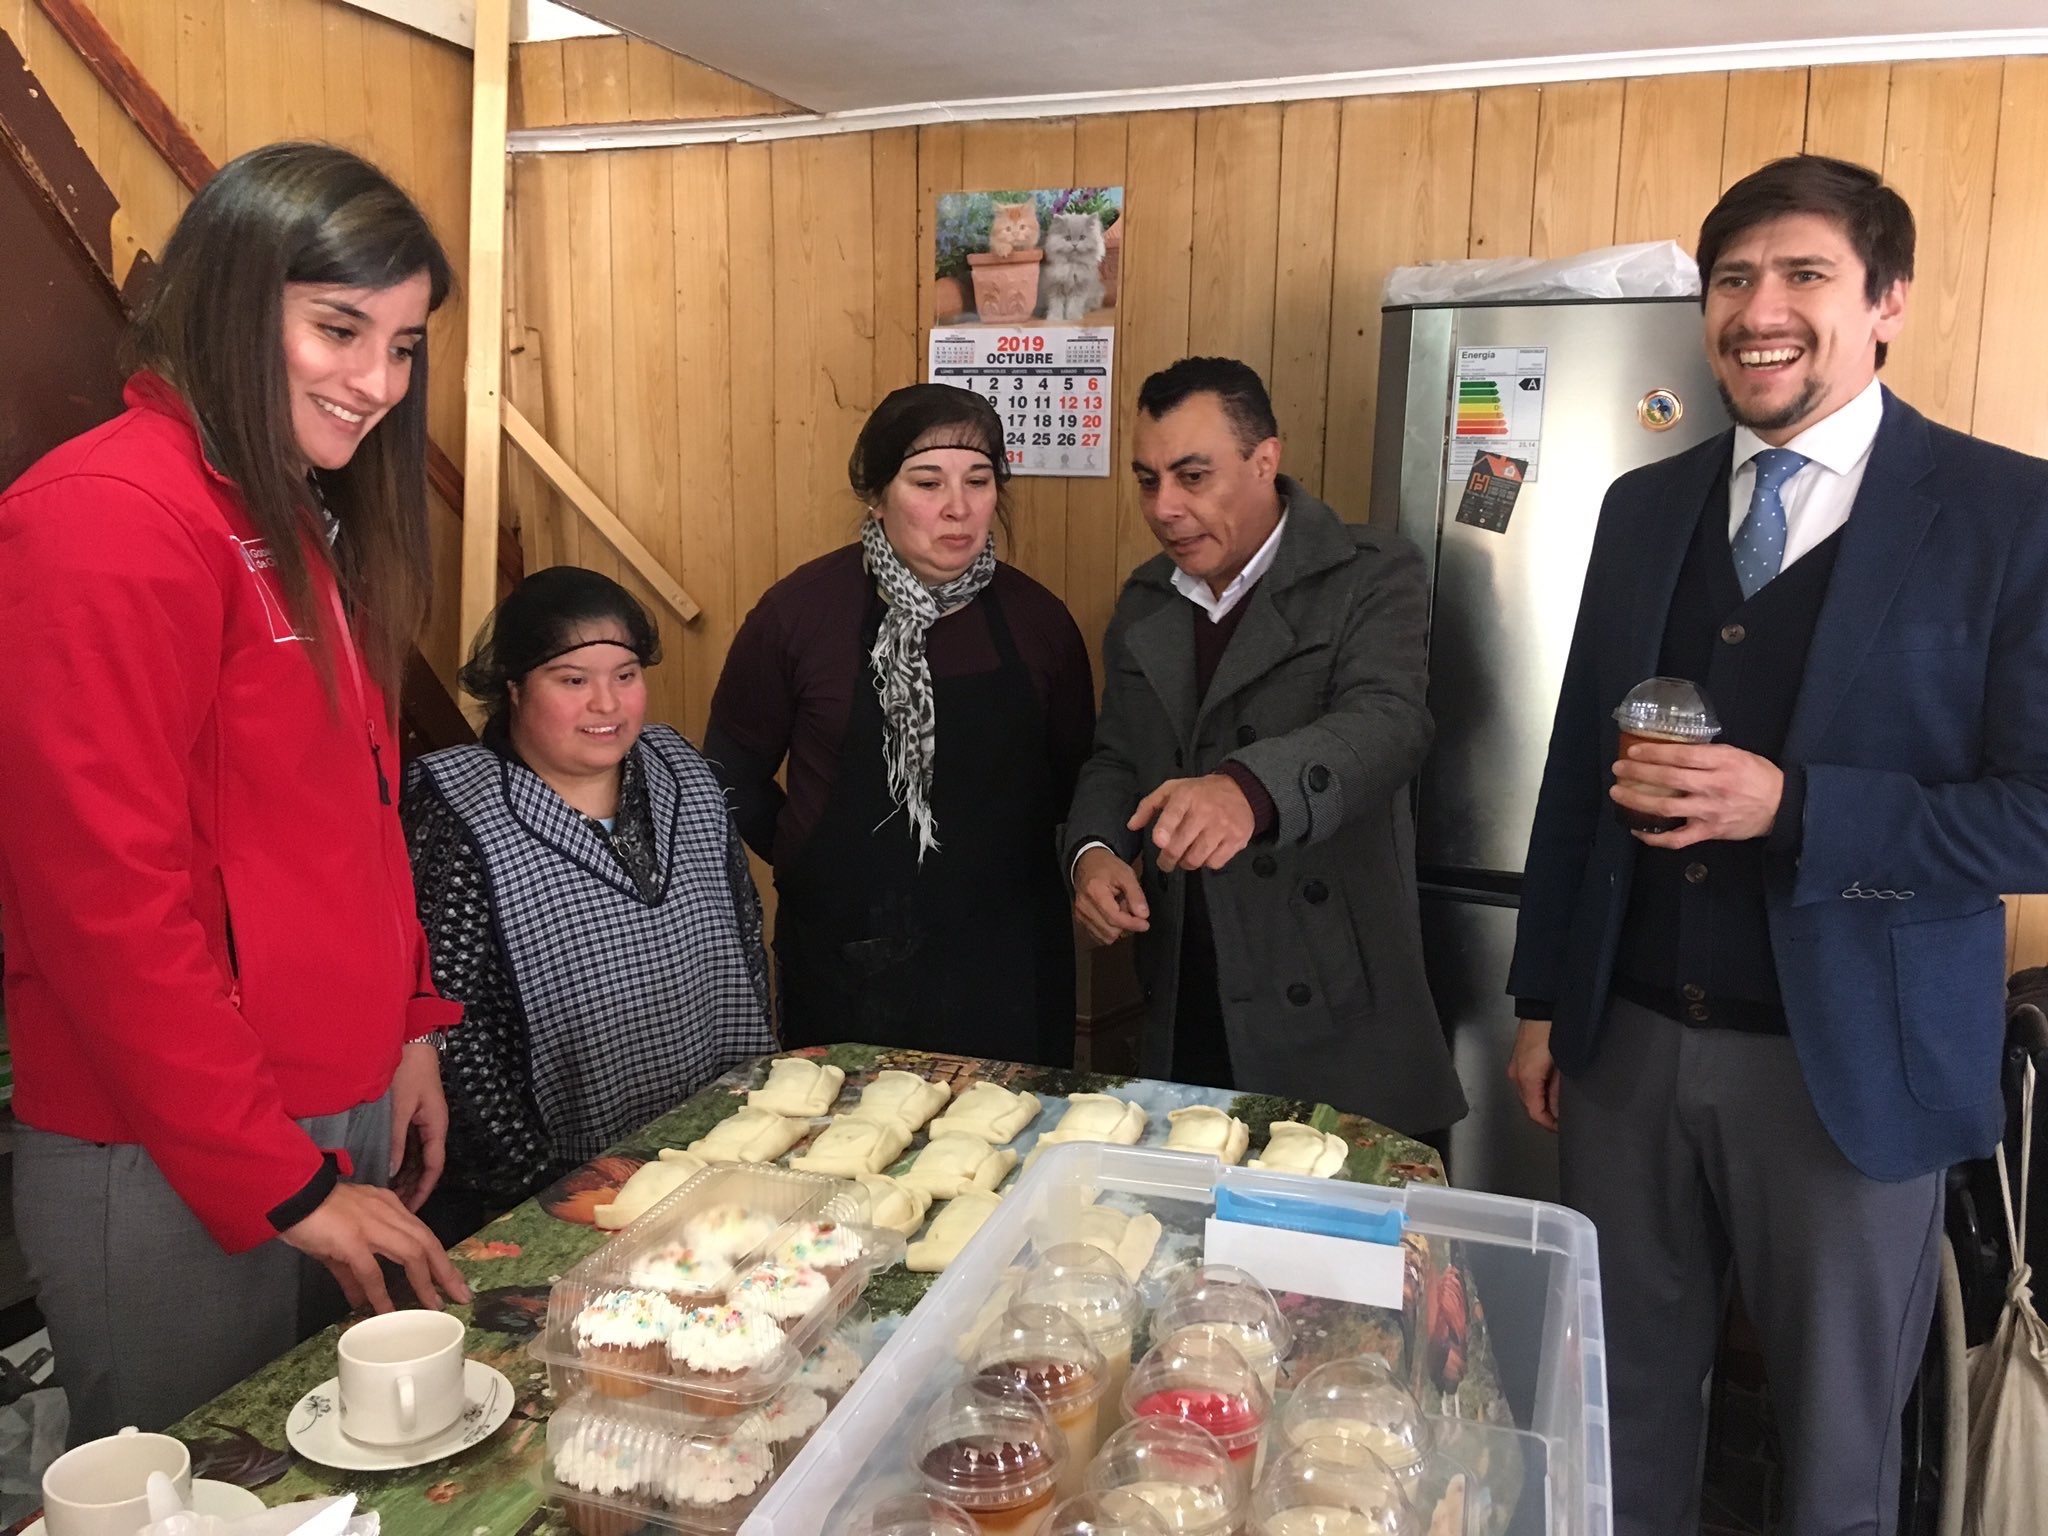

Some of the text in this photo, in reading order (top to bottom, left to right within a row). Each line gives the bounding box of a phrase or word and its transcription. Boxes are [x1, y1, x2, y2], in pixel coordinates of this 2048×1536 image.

[997, 336, 1044, 352] 2019
[986, 353, 1053, 364] OCTUBRE
[1461, 350, 1496, 360] Energía
[966, 378, 1098, 390] 1 2 3 4 5 6
[1527, 379, 1538, 390] A
[990, 396, 1102, 409] 9 10 11 12 13
[1008, 415, 1026, 427] 17
[1033, 415, 1051, 427] 18
[1058, 415, 1076, 427] 19
[1082, 415, 1102, 428] 20
[1006, 432, 1101, 446] 24 25 26 27
[1007, 451, 1024, 463] 31
